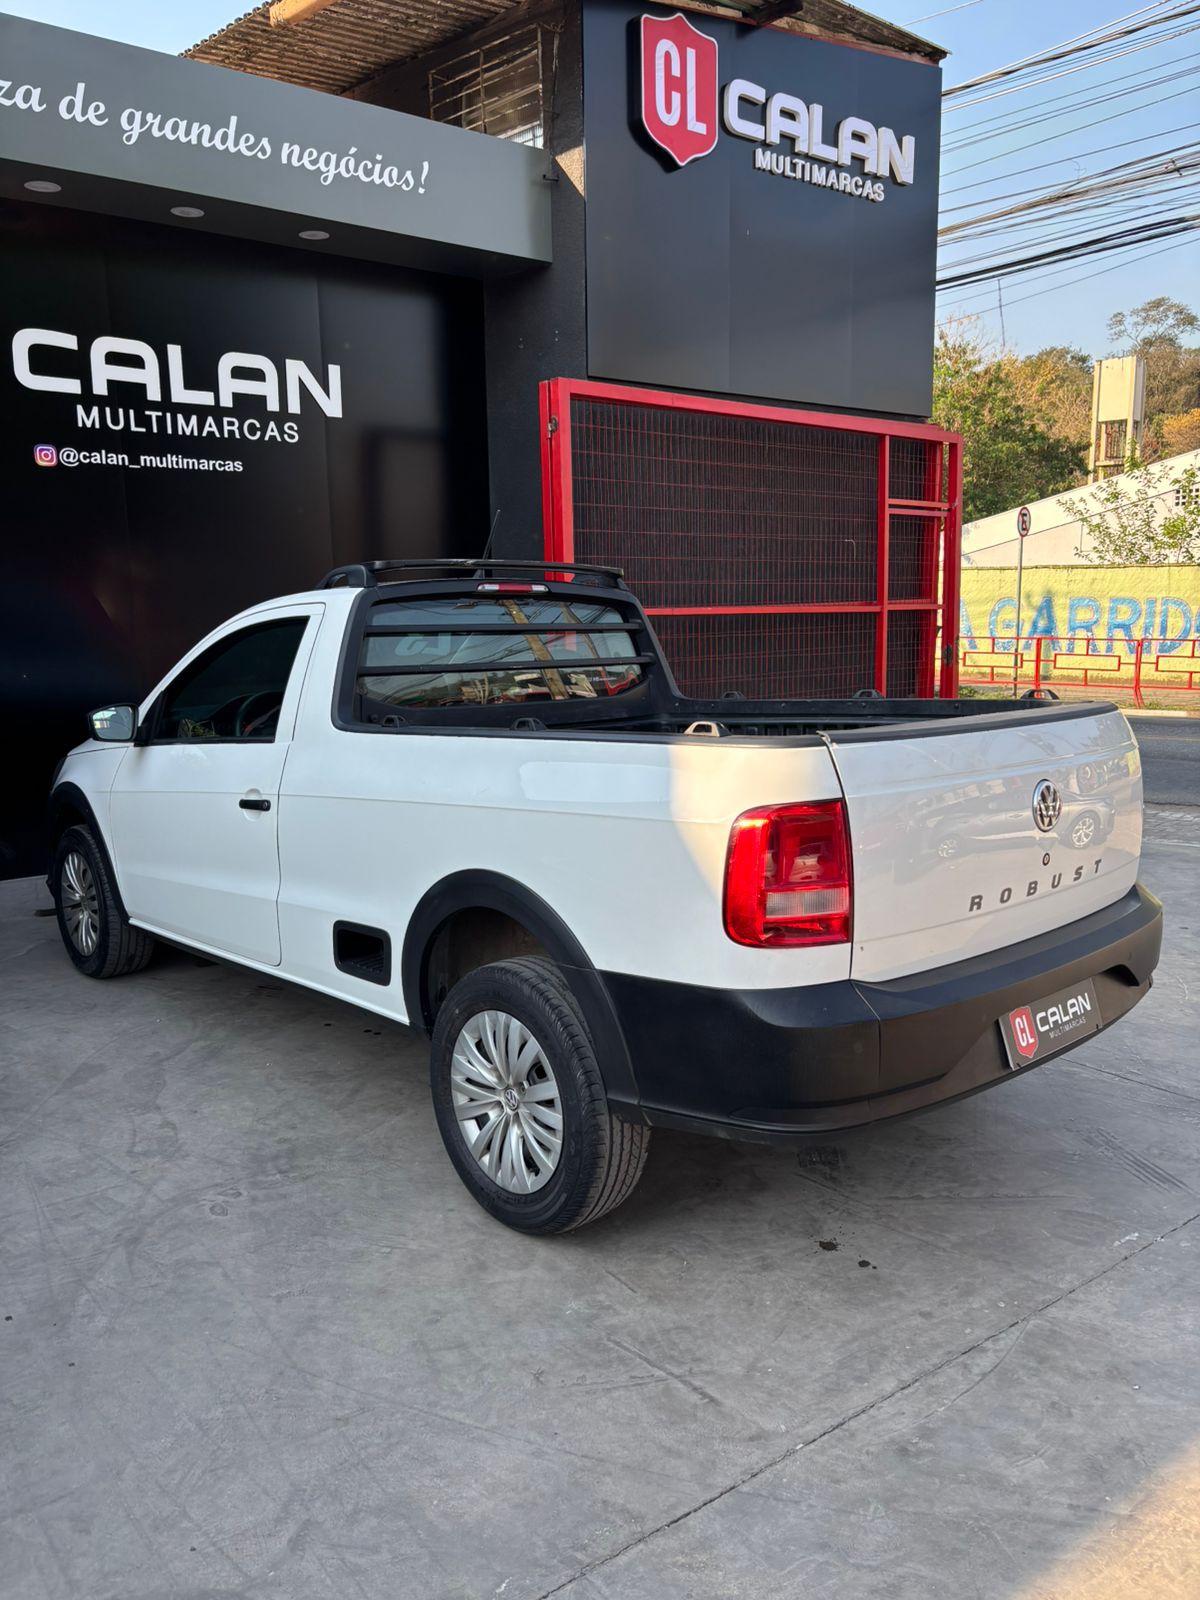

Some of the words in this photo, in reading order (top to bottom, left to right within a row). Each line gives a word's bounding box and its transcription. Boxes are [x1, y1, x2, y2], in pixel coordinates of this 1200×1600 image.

[655, 38, 707, 136] CL
[58, 82, 109, 127] de
[120, 108, 272, 160] grandes
[280, 142, 430, 195] negócios!
[723, 78, 916, 185] CALAN
[755, 147, 886, 202] MULTIMARCAS
[11, 327, 343, 419] CALAN
[76, 404, 300, 443] MULTIMARCAS
[59, 447, 244, 472] @calan_multimarcas
[968, 859, 1102, 912] ROBUST
[1014, 1014, 1035, 1047] CL
[1036, 992, 1092, 1033] CALAN
[1049, 1016, 1087, 1039] MULTIMARCAS
